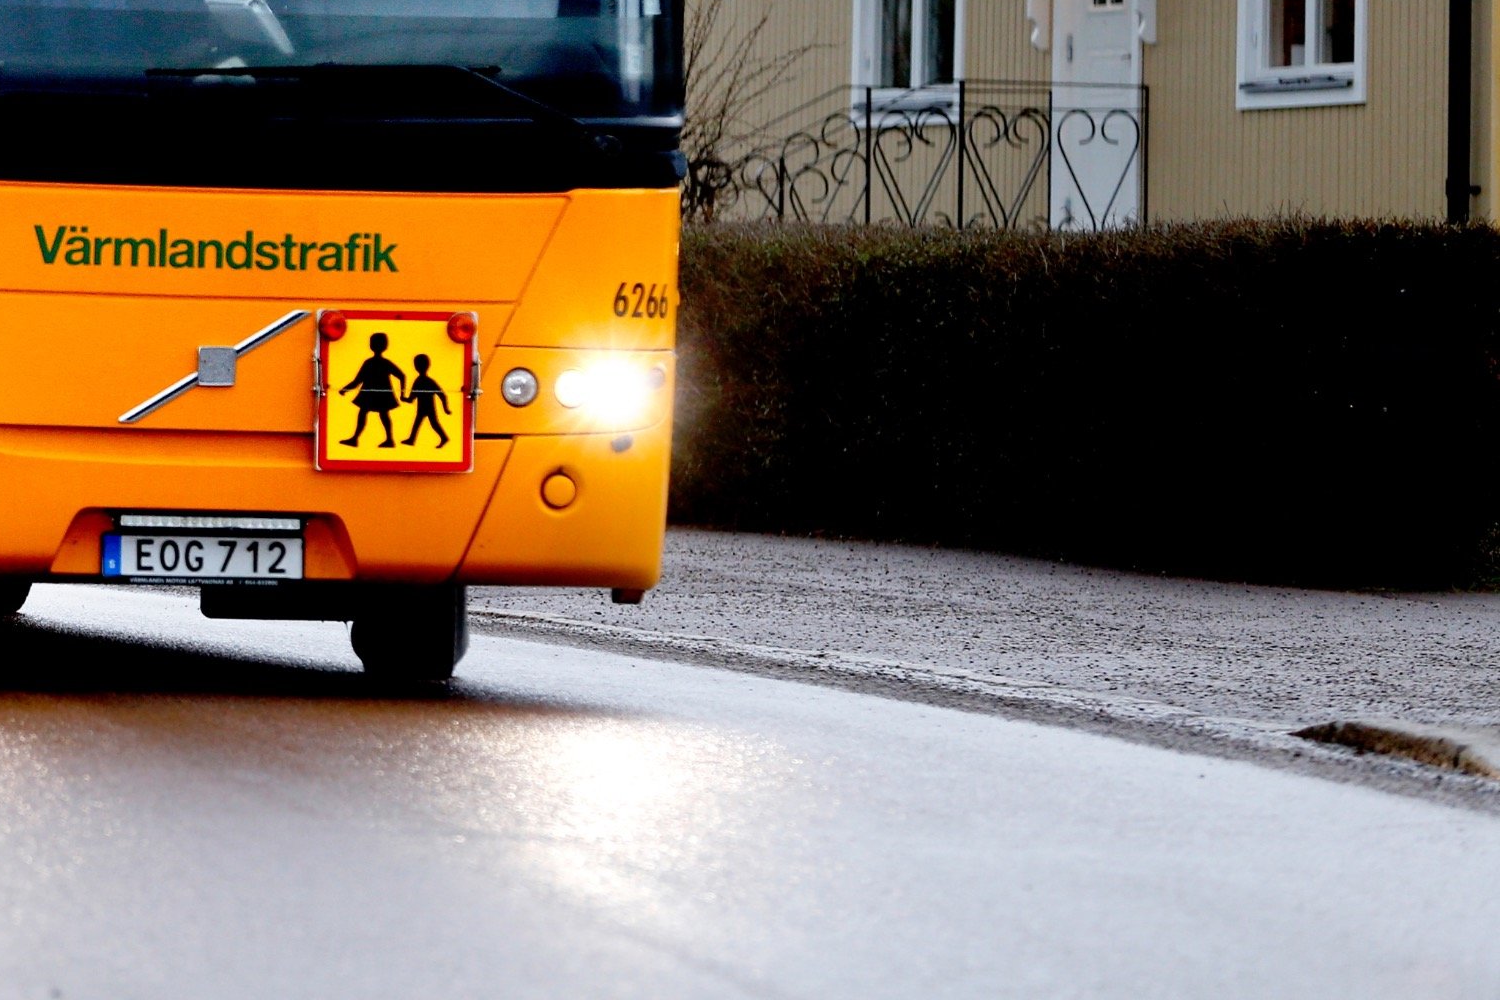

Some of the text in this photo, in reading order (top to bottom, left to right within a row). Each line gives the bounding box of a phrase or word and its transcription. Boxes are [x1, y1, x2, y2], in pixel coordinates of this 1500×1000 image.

[34, 224, 399, 273] Värmlandstrafik
[613, 281, 668, 319] 6266
[136, 538, 287, 574] EOG 712
